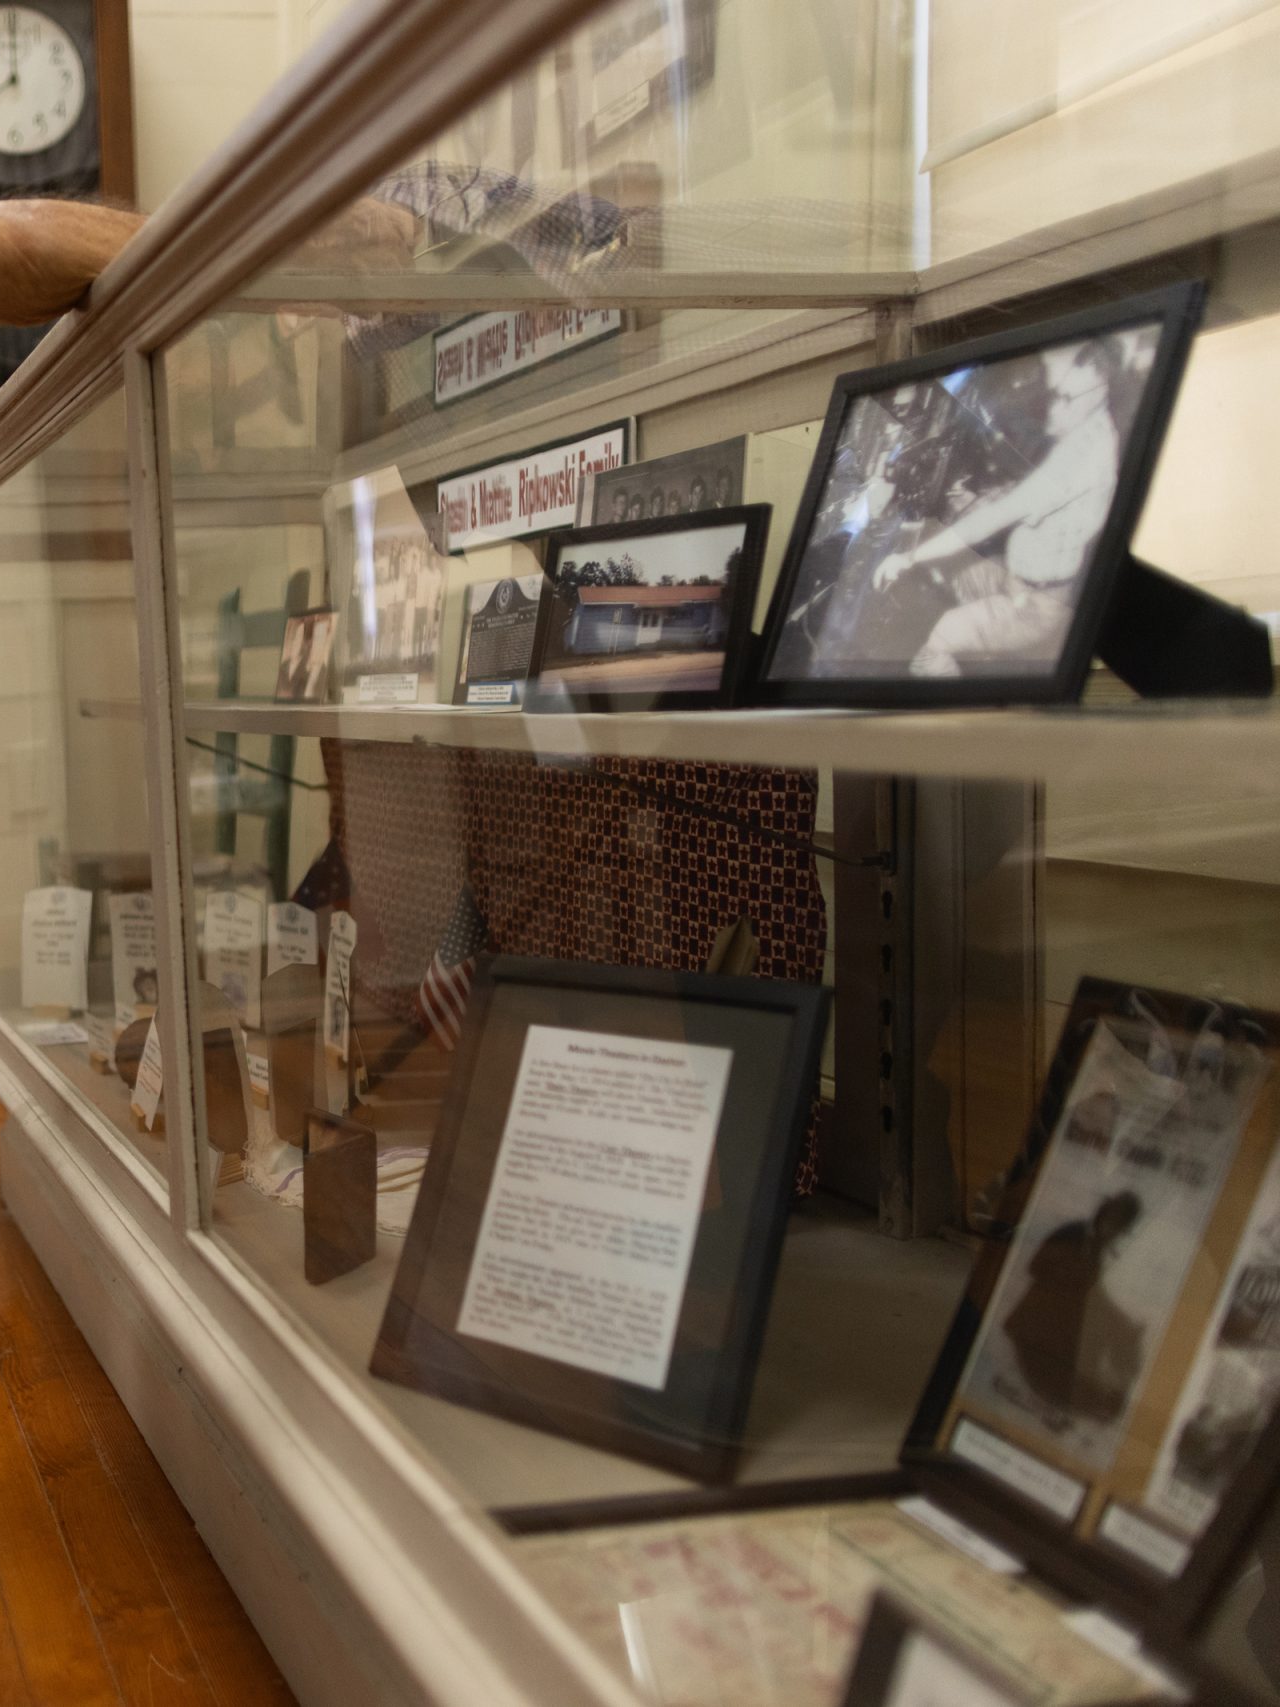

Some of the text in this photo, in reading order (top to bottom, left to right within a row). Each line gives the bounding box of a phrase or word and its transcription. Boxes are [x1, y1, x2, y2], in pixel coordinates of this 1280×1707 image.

[49, 40, 65, 65] 2
[7, 122, 24, 147] 6
[32, 113, 48, 137] 5
[471, 484, 477, 529] &
[519, 455, 576, 527] Ripkowski
